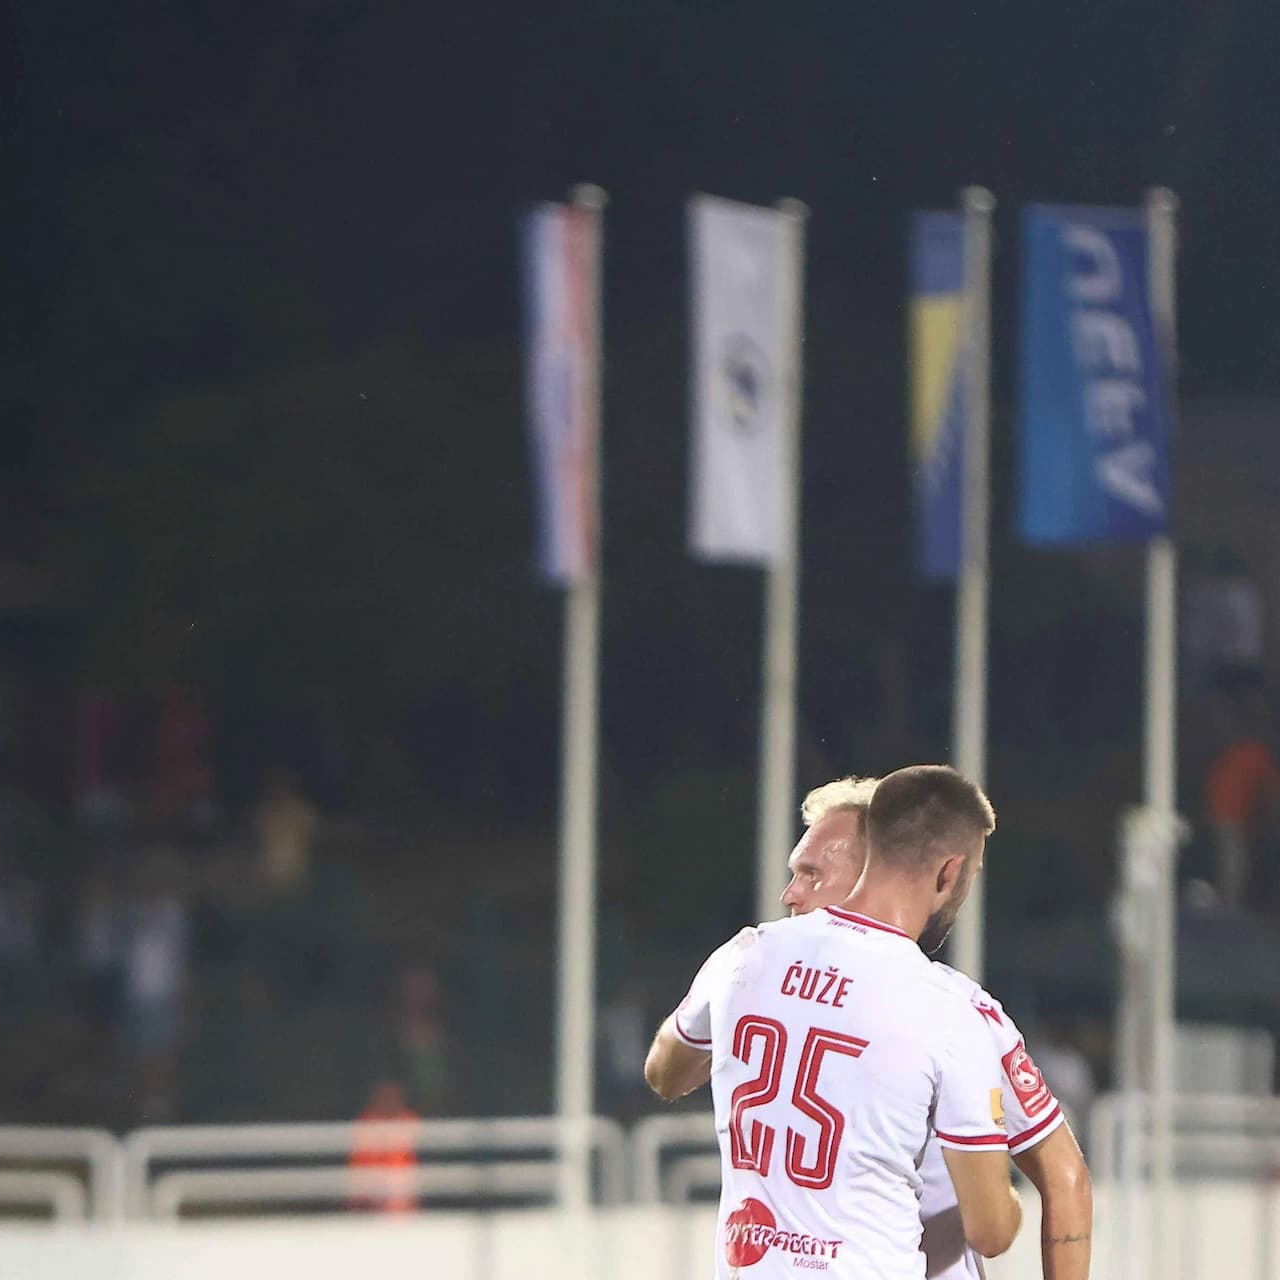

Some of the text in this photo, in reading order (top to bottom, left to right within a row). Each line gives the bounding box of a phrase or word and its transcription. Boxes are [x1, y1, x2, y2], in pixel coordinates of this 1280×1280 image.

[780, 960, 854, 1008] ĆUŽE
[729, 1014, 870, 1190] 25
[793, 1256, 829, 1270] Mostar
